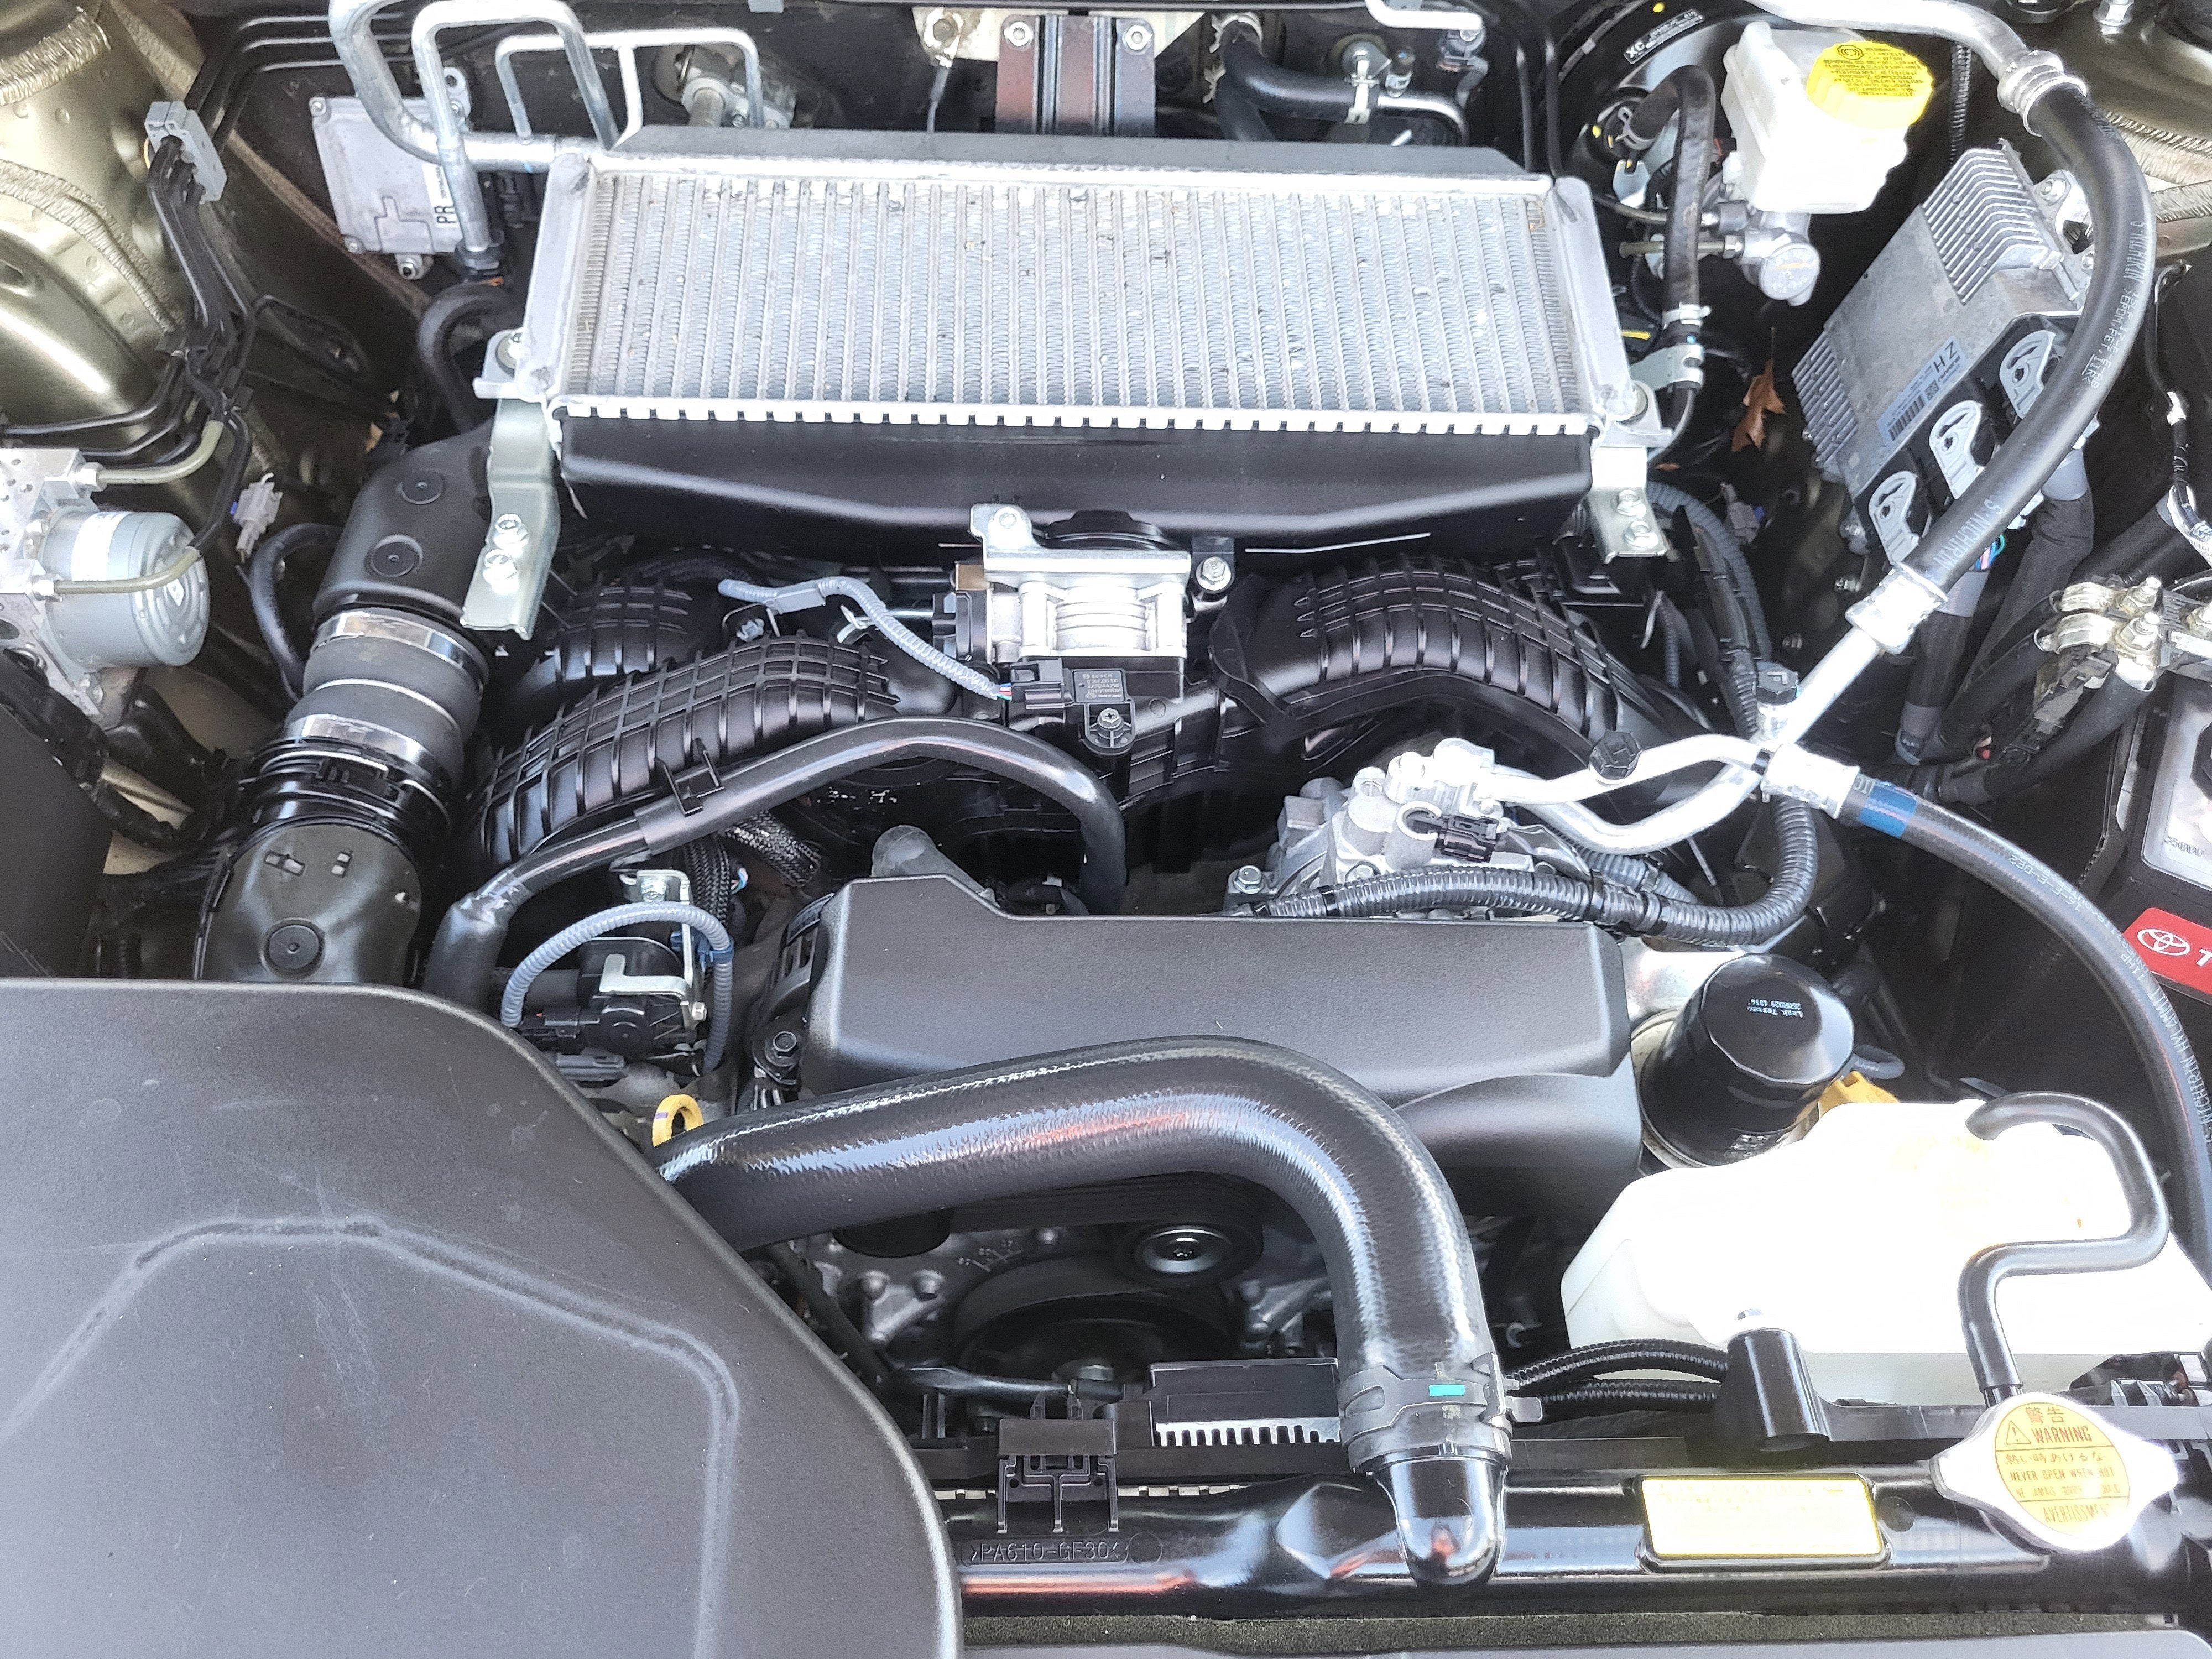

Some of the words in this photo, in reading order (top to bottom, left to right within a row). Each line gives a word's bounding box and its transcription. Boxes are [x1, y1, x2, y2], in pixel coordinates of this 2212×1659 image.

[1626, 41, 1645, 58] XC
[434, 206, 455, 223] PR
[2026, 1407, 2064, 1424] 警告
[2031, 1426, 2093, 1443] WARNING
[2010, 1470, 2038, 1481] NEVER
[2042, 1469, 2065, 1480] OPEN
[2069, 1468, 2094, 1478] WHEN
[2098, 1467, 2115, 1478] HOT
[2016, 1488, 2025, 1498] NE
